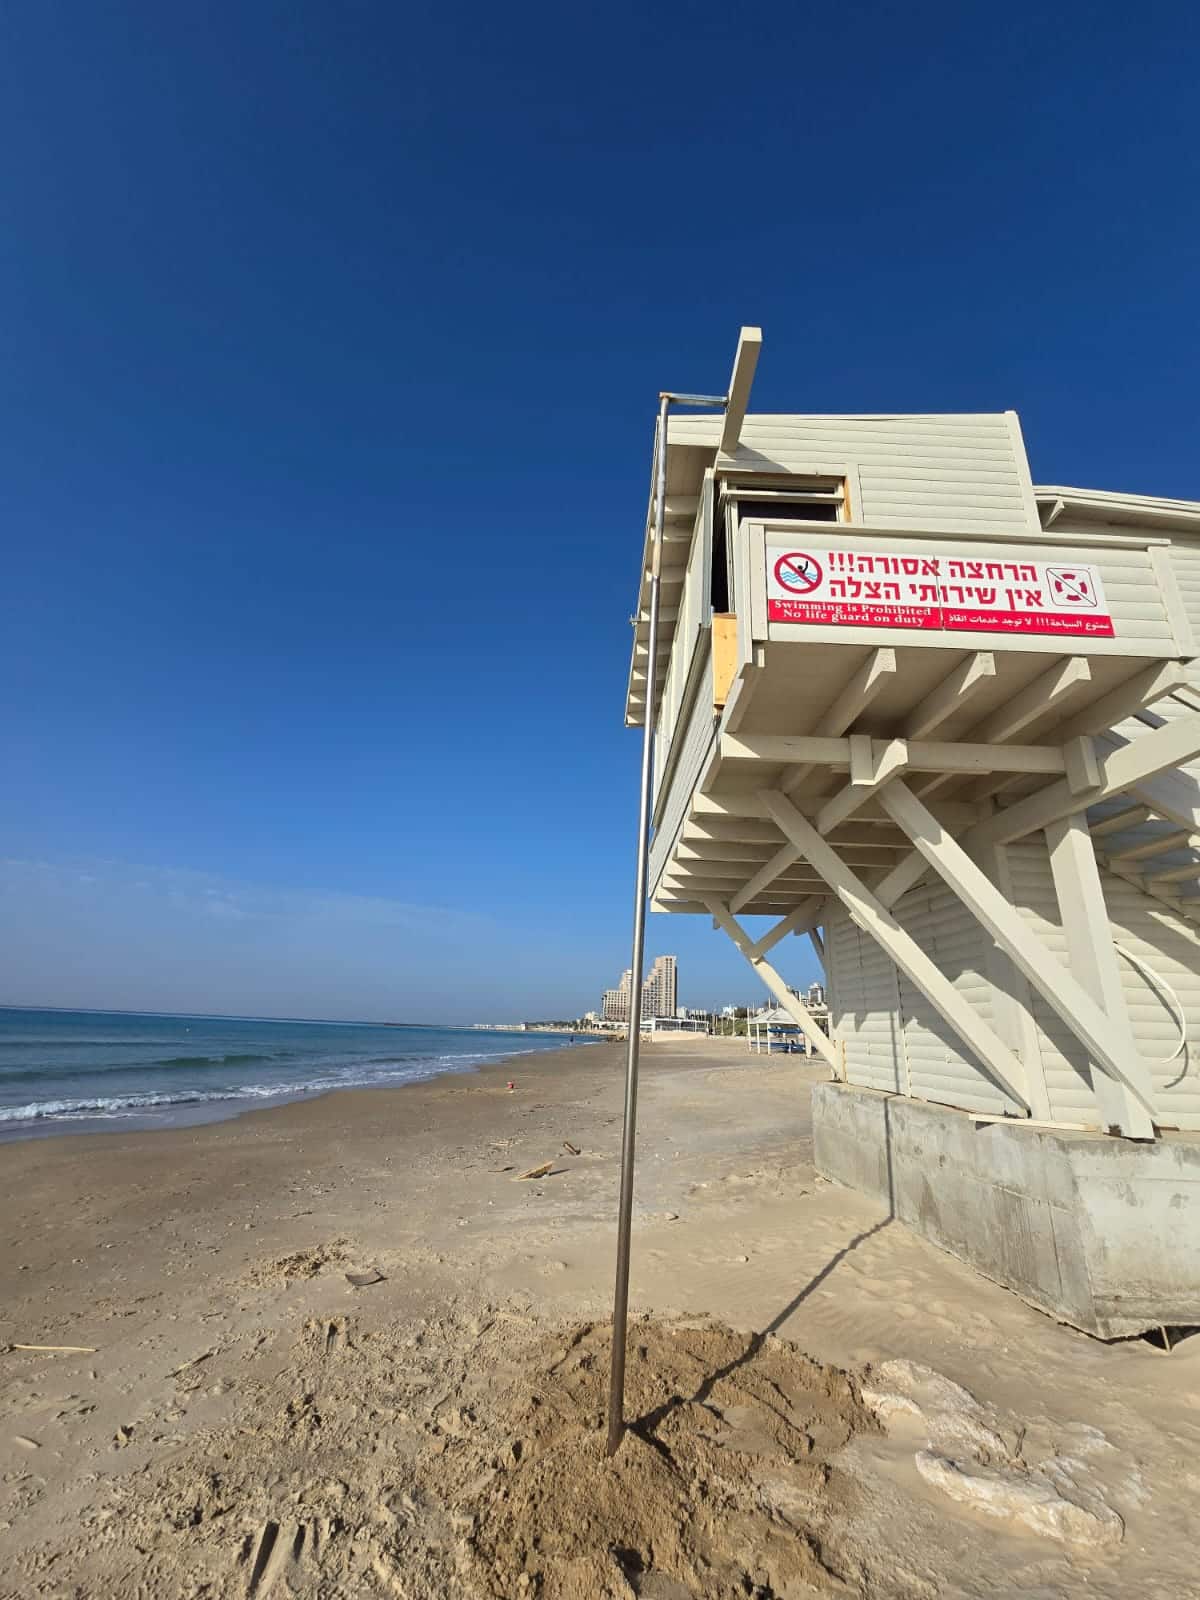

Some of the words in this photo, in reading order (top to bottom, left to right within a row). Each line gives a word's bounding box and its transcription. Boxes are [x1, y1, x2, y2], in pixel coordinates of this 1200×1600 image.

[828, 552, 942, 577] אסורה!!!
[948, 560, 1038, 582] הרחצה
[829, 576, 901, 601] הצלה
[909, 583, 997, 605] שירותי
[1005, 588, 1045, 611] אין
[774, 600, 843, 616] Swimming
[847, 603, 857, 612] is
[861, 604, 932, 616] Prohibited
[783, 609, 801, 618] No
[805, 609, 828, 620] life
[831, 611, 870, 624] guard
[894, 614, 925, 627] duty
